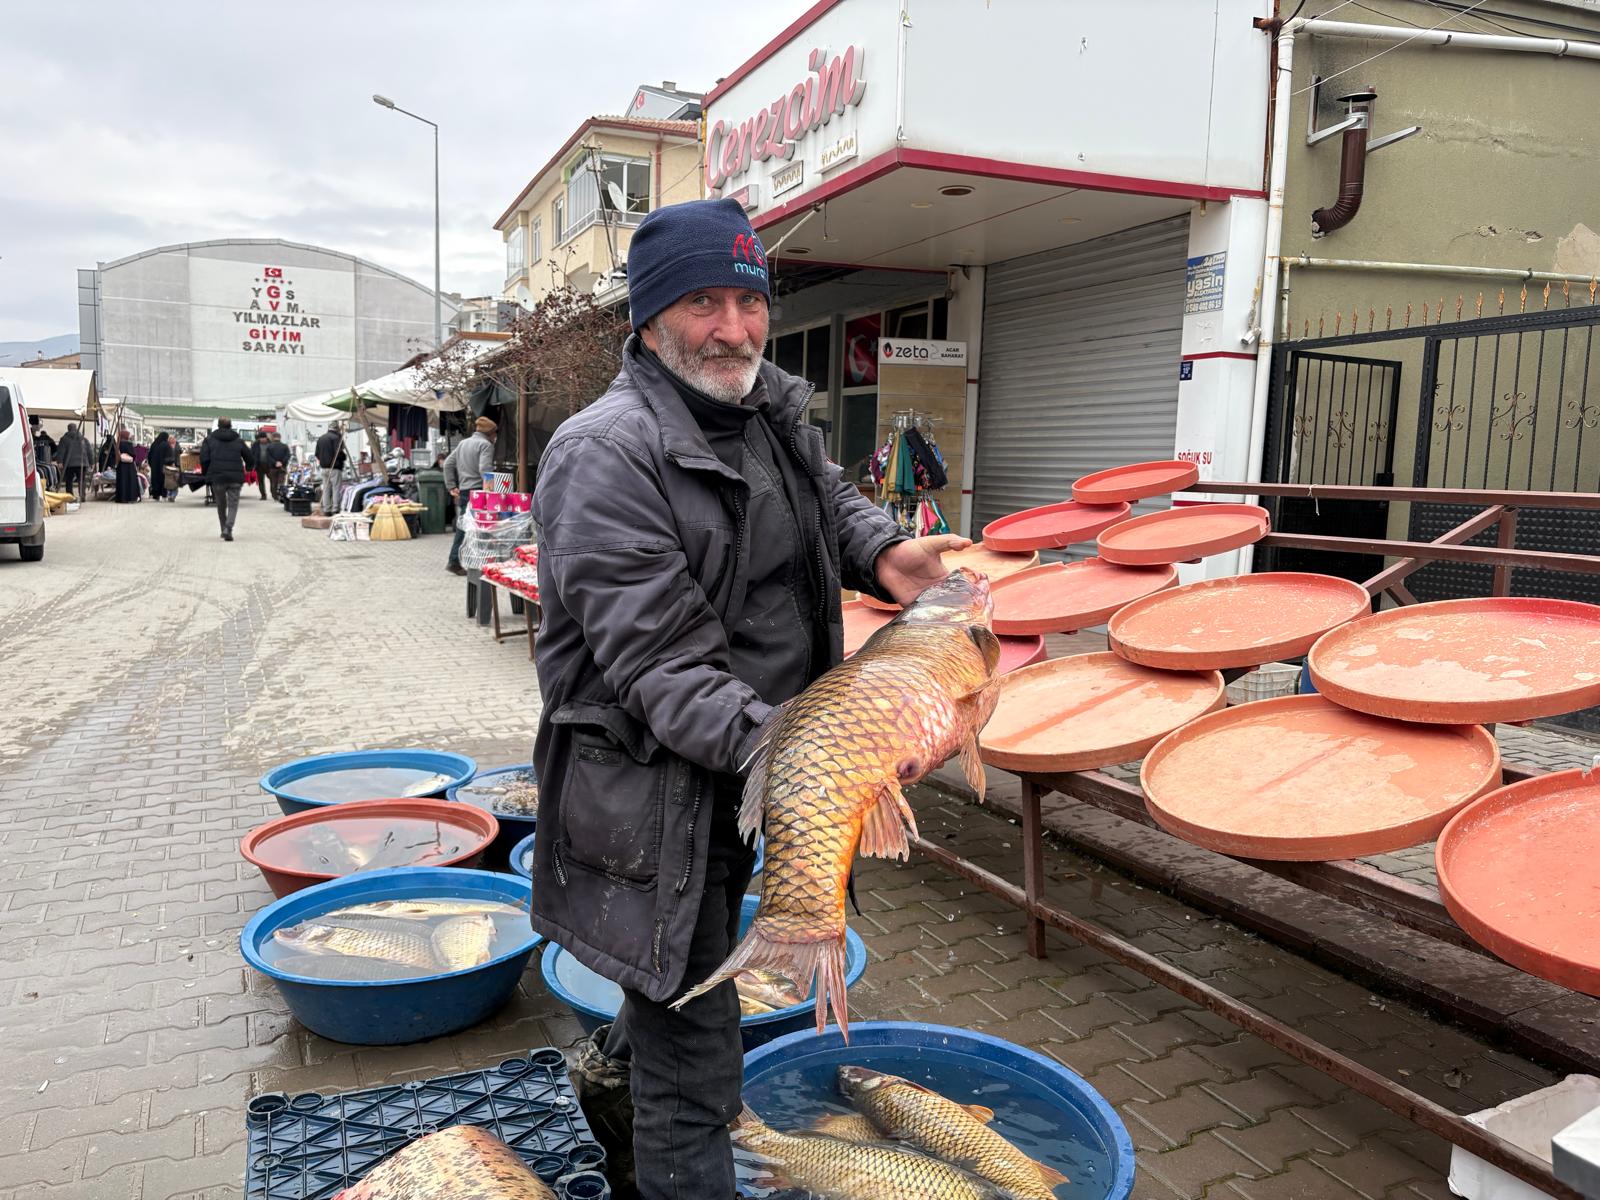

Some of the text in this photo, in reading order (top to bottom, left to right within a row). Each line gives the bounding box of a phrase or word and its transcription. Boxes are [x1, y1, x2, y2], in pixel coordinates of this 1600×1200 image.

[1187, 273, 1223, 297] yasin
[232, 311, 321, 329] YILMAZLAR
[249, 325, 302, 343] GİYİM
[242, 341, 305, 355] SARAYI
[895, 345, 929, 359] zeta
[1202, 452, 1213, 465] SU
